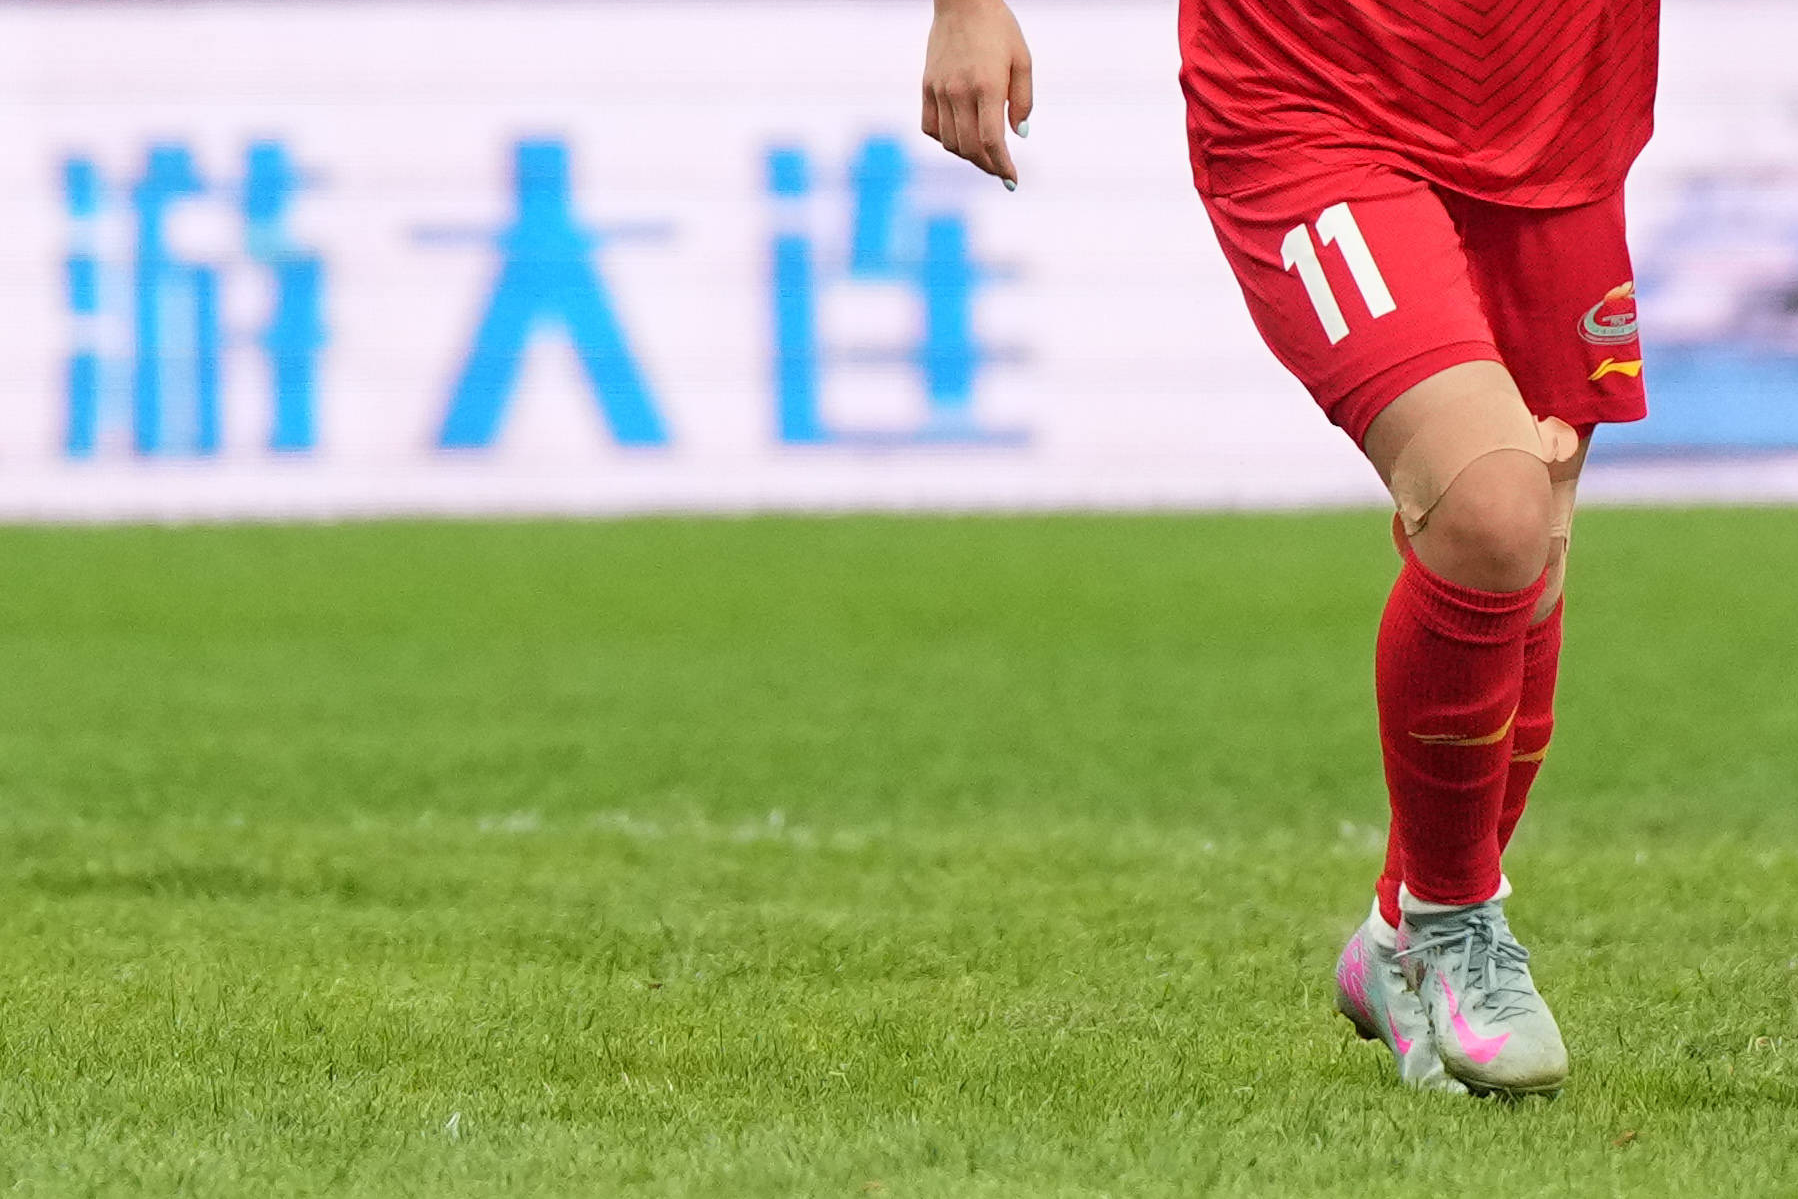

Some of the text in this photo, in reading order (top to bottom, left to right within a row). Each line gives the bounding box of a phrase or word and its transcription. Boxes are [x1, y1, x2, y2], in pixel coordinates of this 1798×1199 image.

[62, 137, 1034, 458] 游大连
[1280, 201, 1397, 345] 11
